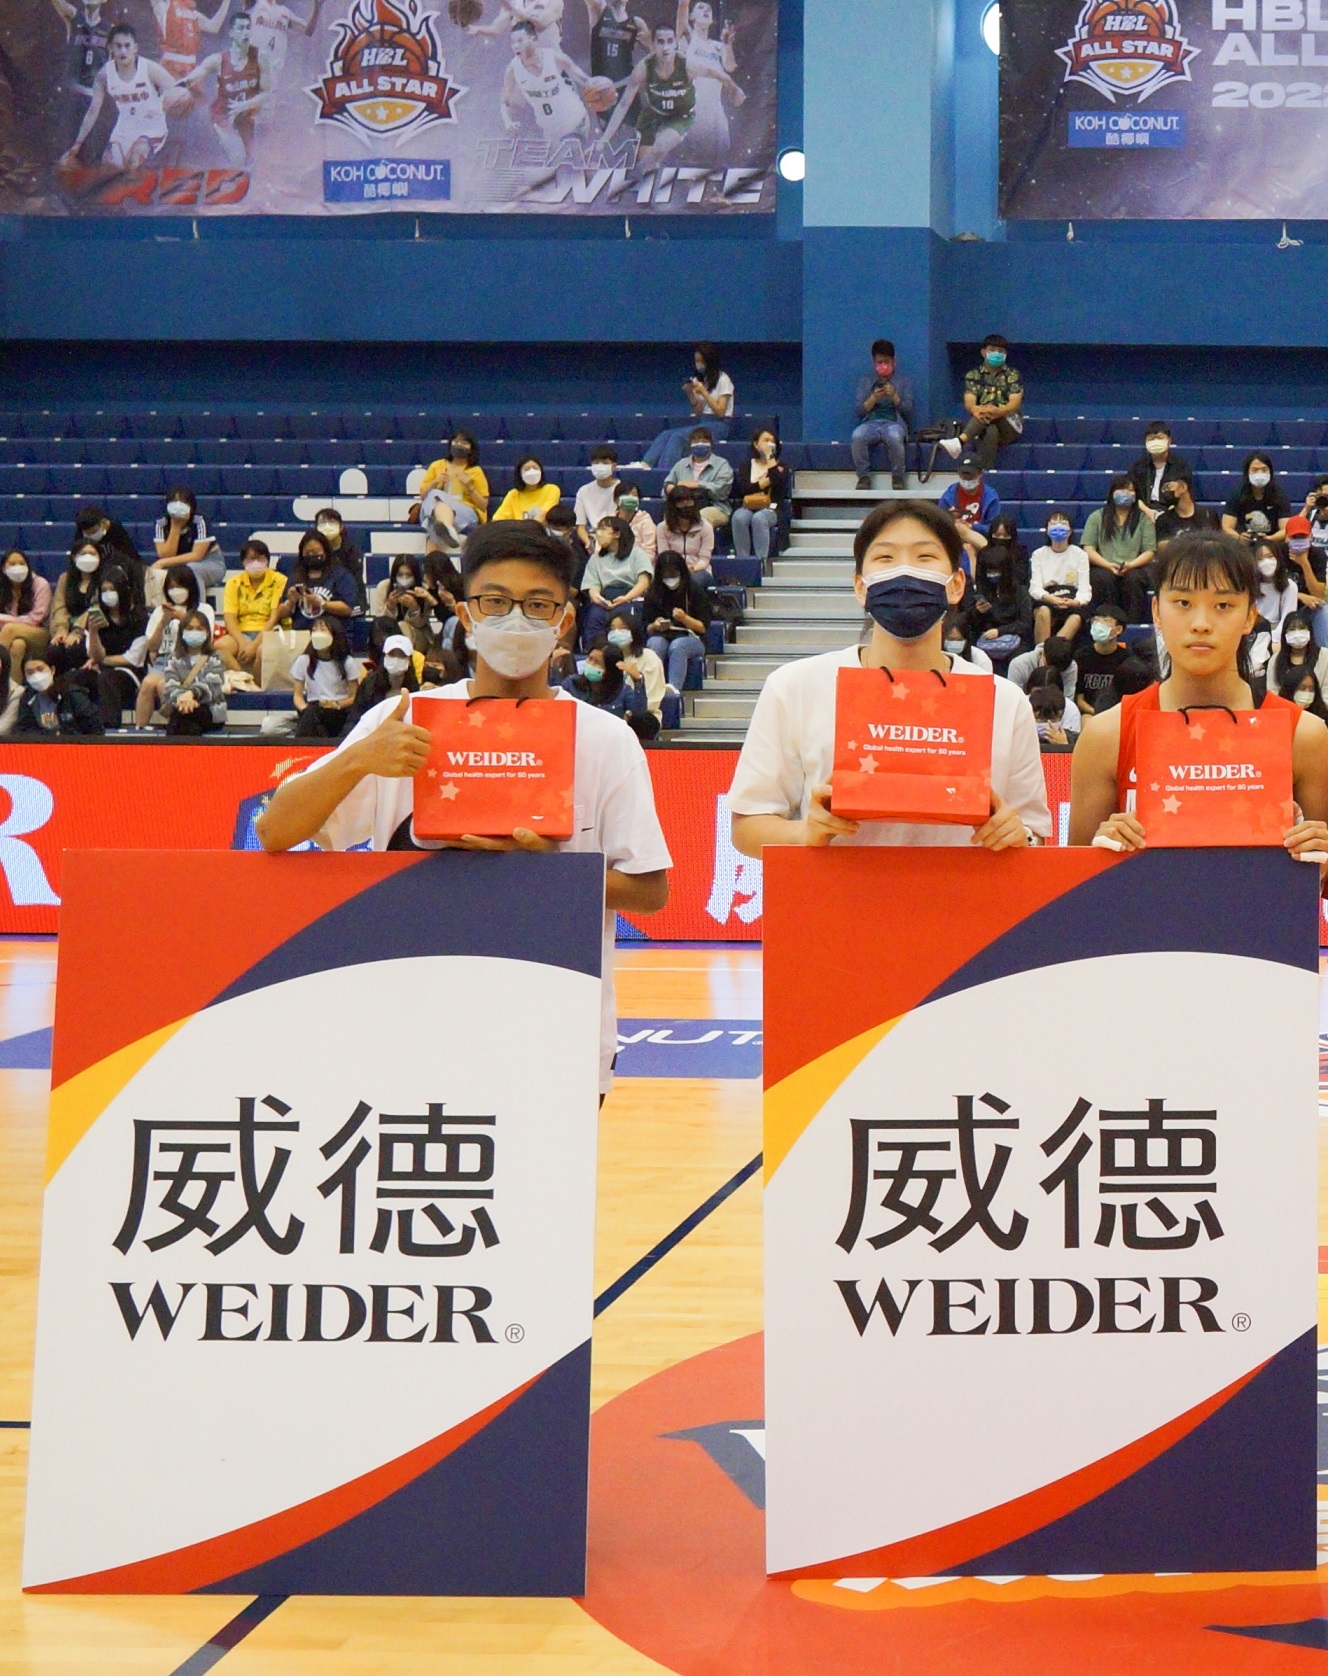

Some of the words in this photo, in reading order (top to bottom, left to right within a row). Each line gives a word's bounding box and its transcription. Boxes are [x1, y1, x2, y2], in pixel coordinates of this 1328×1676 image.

[1104, 15, 1148, 31] HBL
[361, 48, 407, 66] HBL
[1080, 41, 1118, 57] ALL
[1122, 40, 1174, 57] STAR
[335, 78, 374, 98] ALL
[377, 75, 438, 97] STAR
[1075, 117, 1106, 130] KOH
[331, 166, 364, 182] KOH
[510, 167, 765, 203] WHITE
[111, 1094, 500, 1257] 威德
[835, 1092, 1225, 1253] 威德
